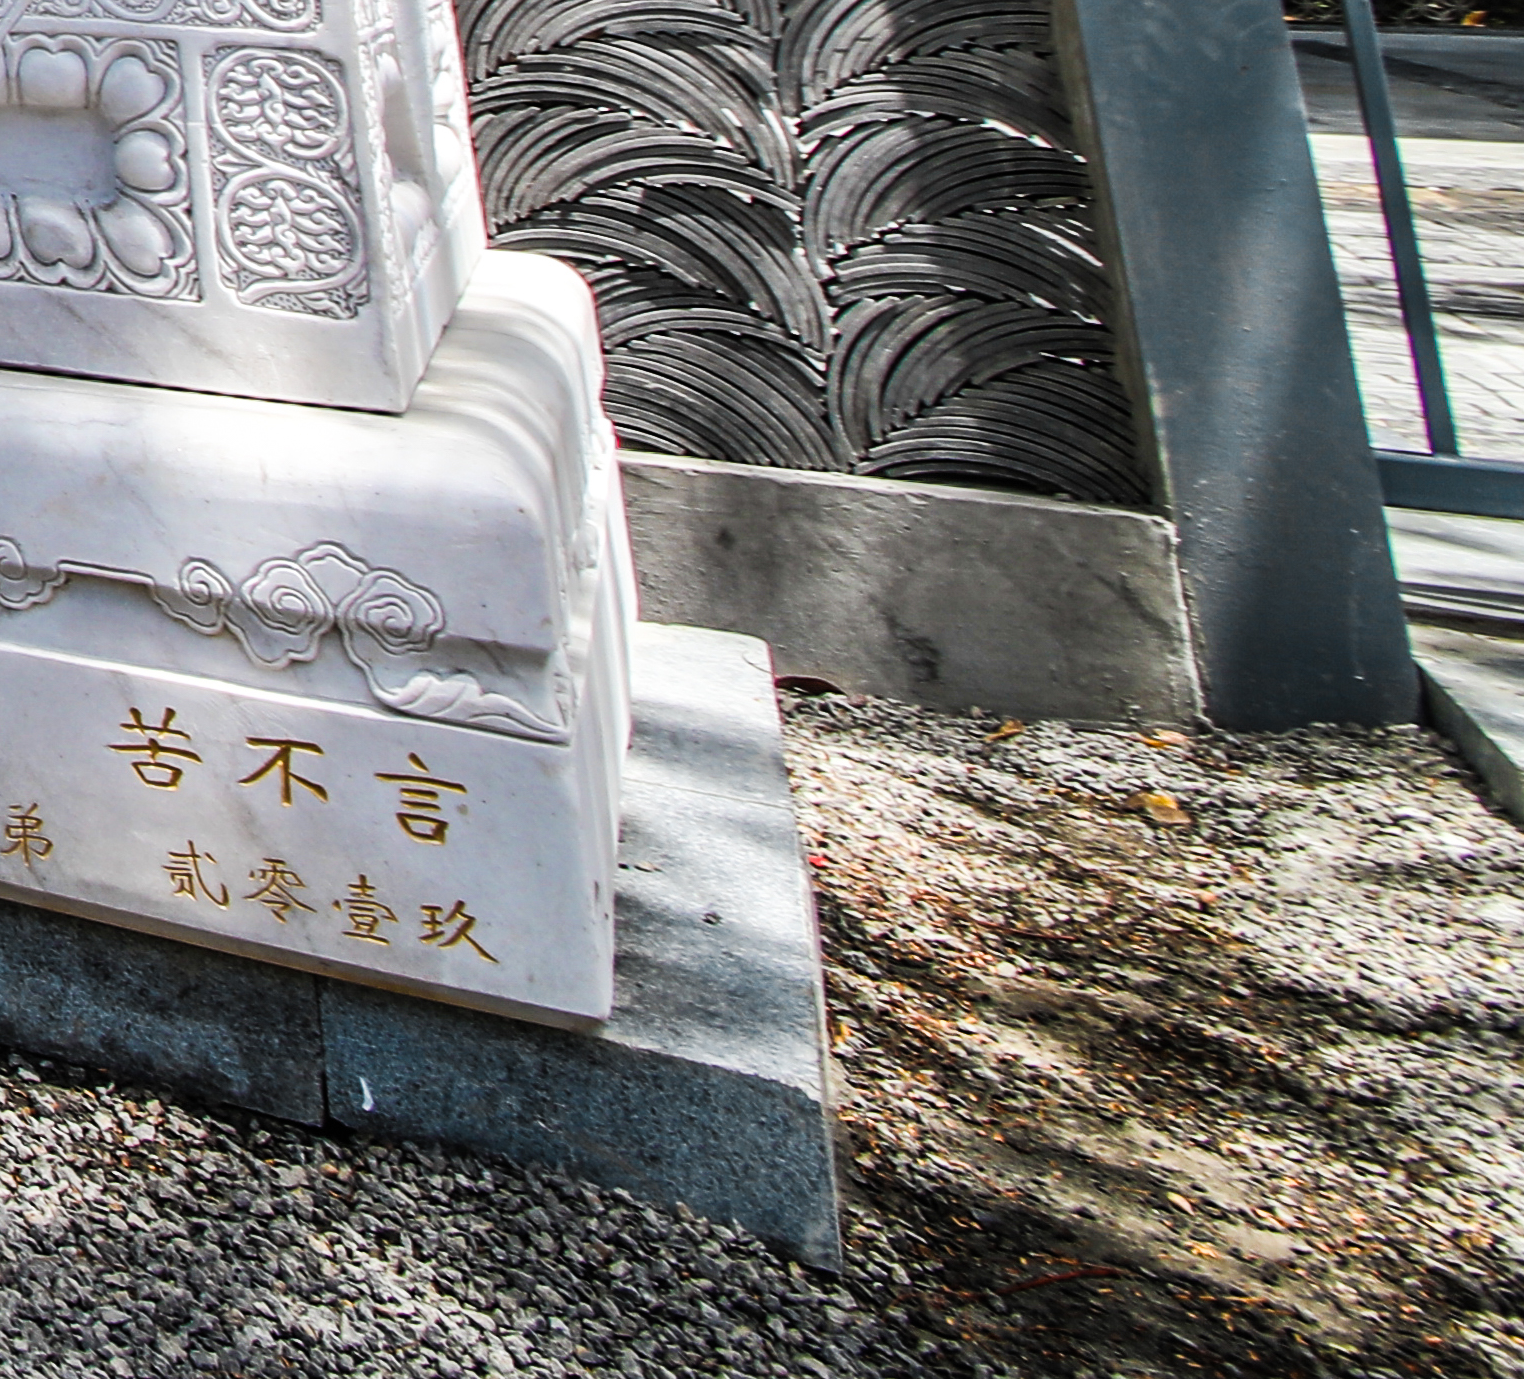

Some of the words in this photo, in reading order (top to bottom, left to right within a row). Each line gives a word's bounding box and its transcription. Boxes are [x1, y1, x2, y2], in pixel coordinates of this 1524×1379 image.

[106, 706, 468, 847] 苦不言
[161, 840, 501, 964] 贰零壹玖
